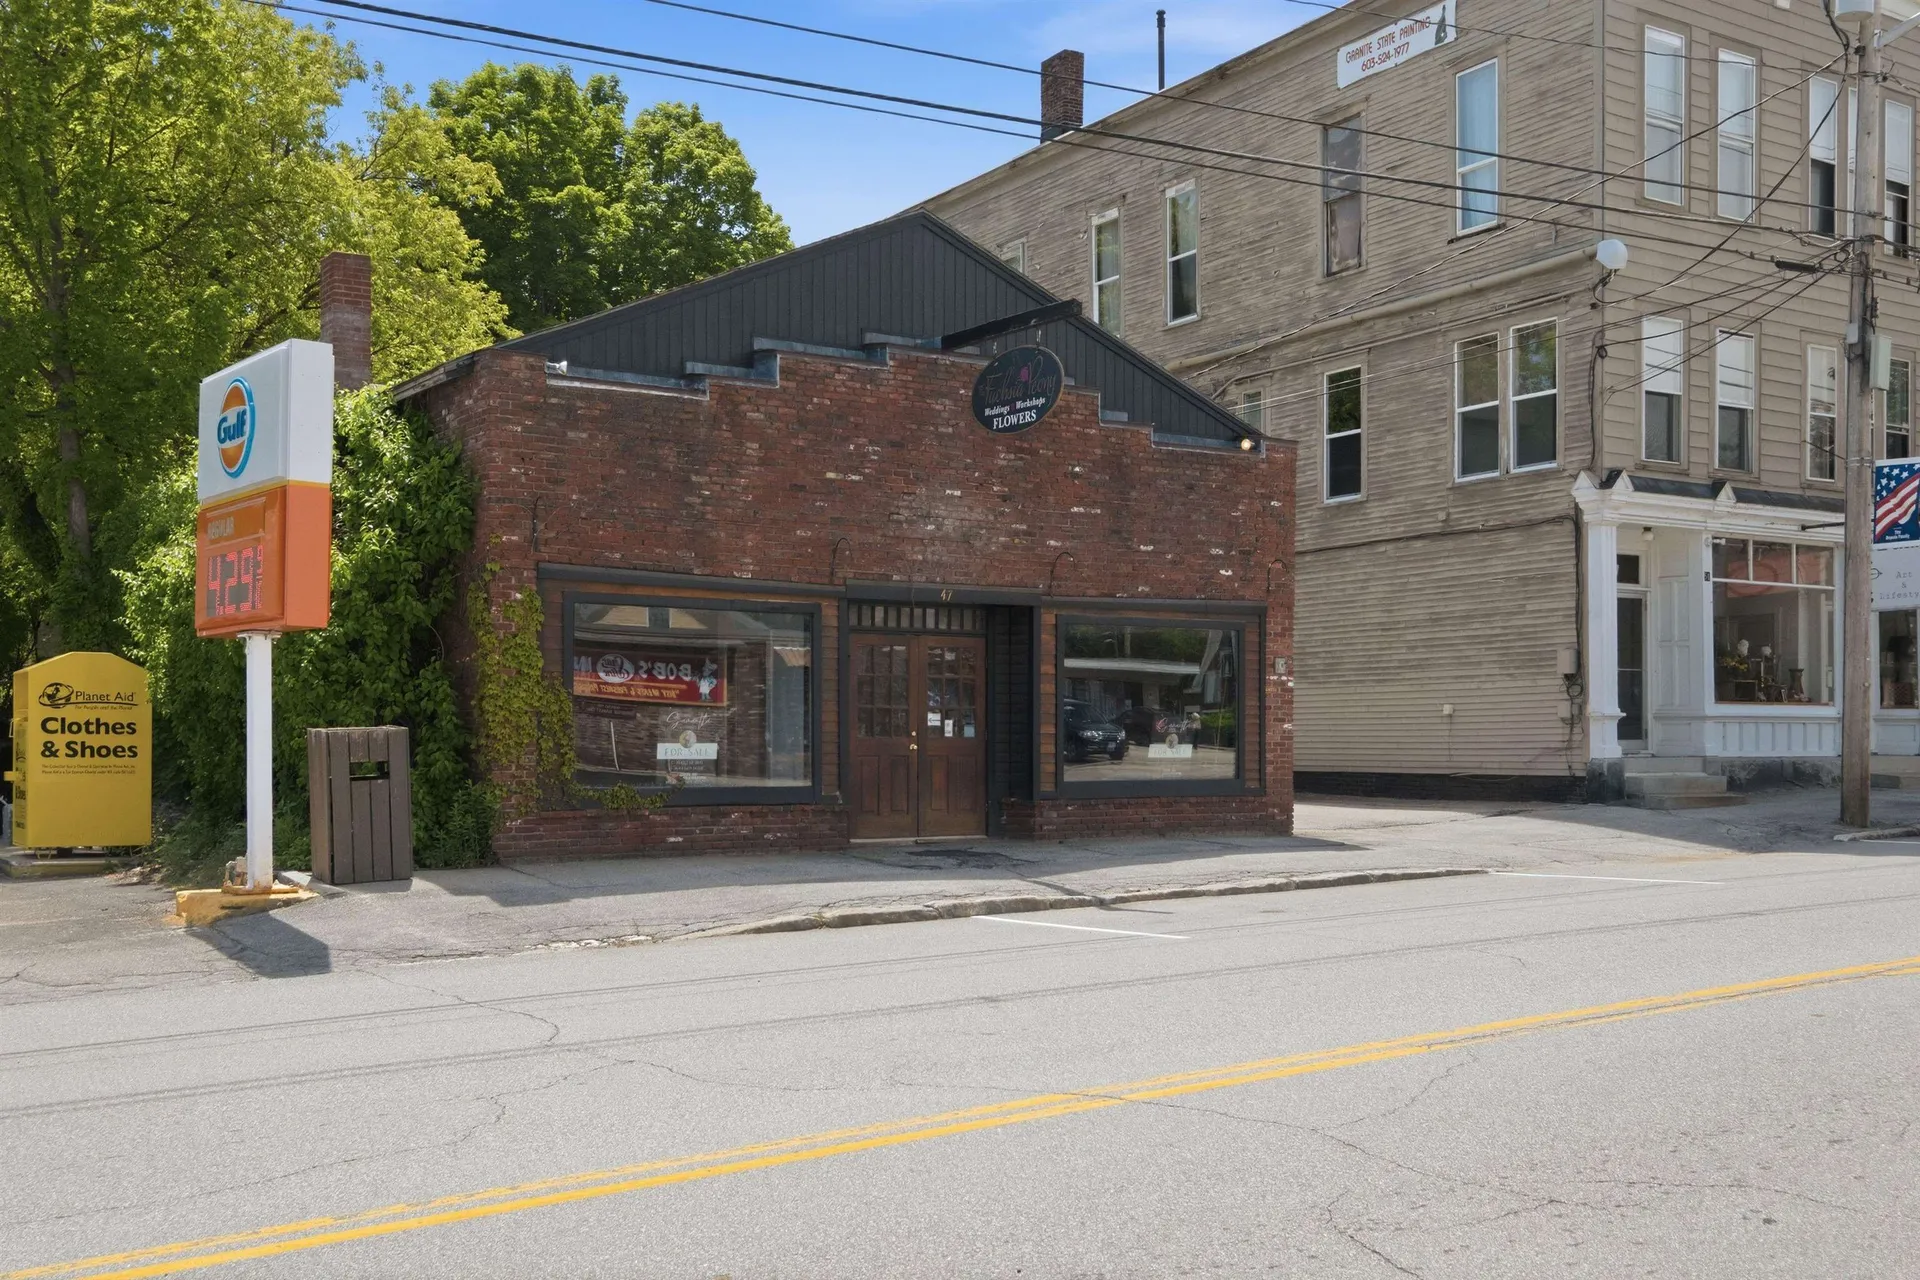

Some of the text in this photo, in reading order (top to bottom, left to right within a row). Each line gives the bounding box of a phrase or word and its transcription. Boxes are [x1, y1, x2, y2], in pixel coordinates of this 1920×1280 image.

[1345, 16, 1431, 64] GRANITE STATE PAINTING
[1361, 41, 1410, 72] 603-524-1977
[984, 396, 1046, 417] Weddings Workshops
[217, 408, 248, 444] Gulf
[992, 409, 1037, 430] FLOWERS
[207, 516, 235, 538] REGULAR
[1895, 571, 1913, 579] Art
[940, 589, 954, 602] 47
[75, 691, 135, 702] Planet Aid
[40, 716, 137, 735] Clothes
[40, 740, 60, 758] &
[65, 740, 138, 758] Shoes
[664, 747, 683, 757] FOR
